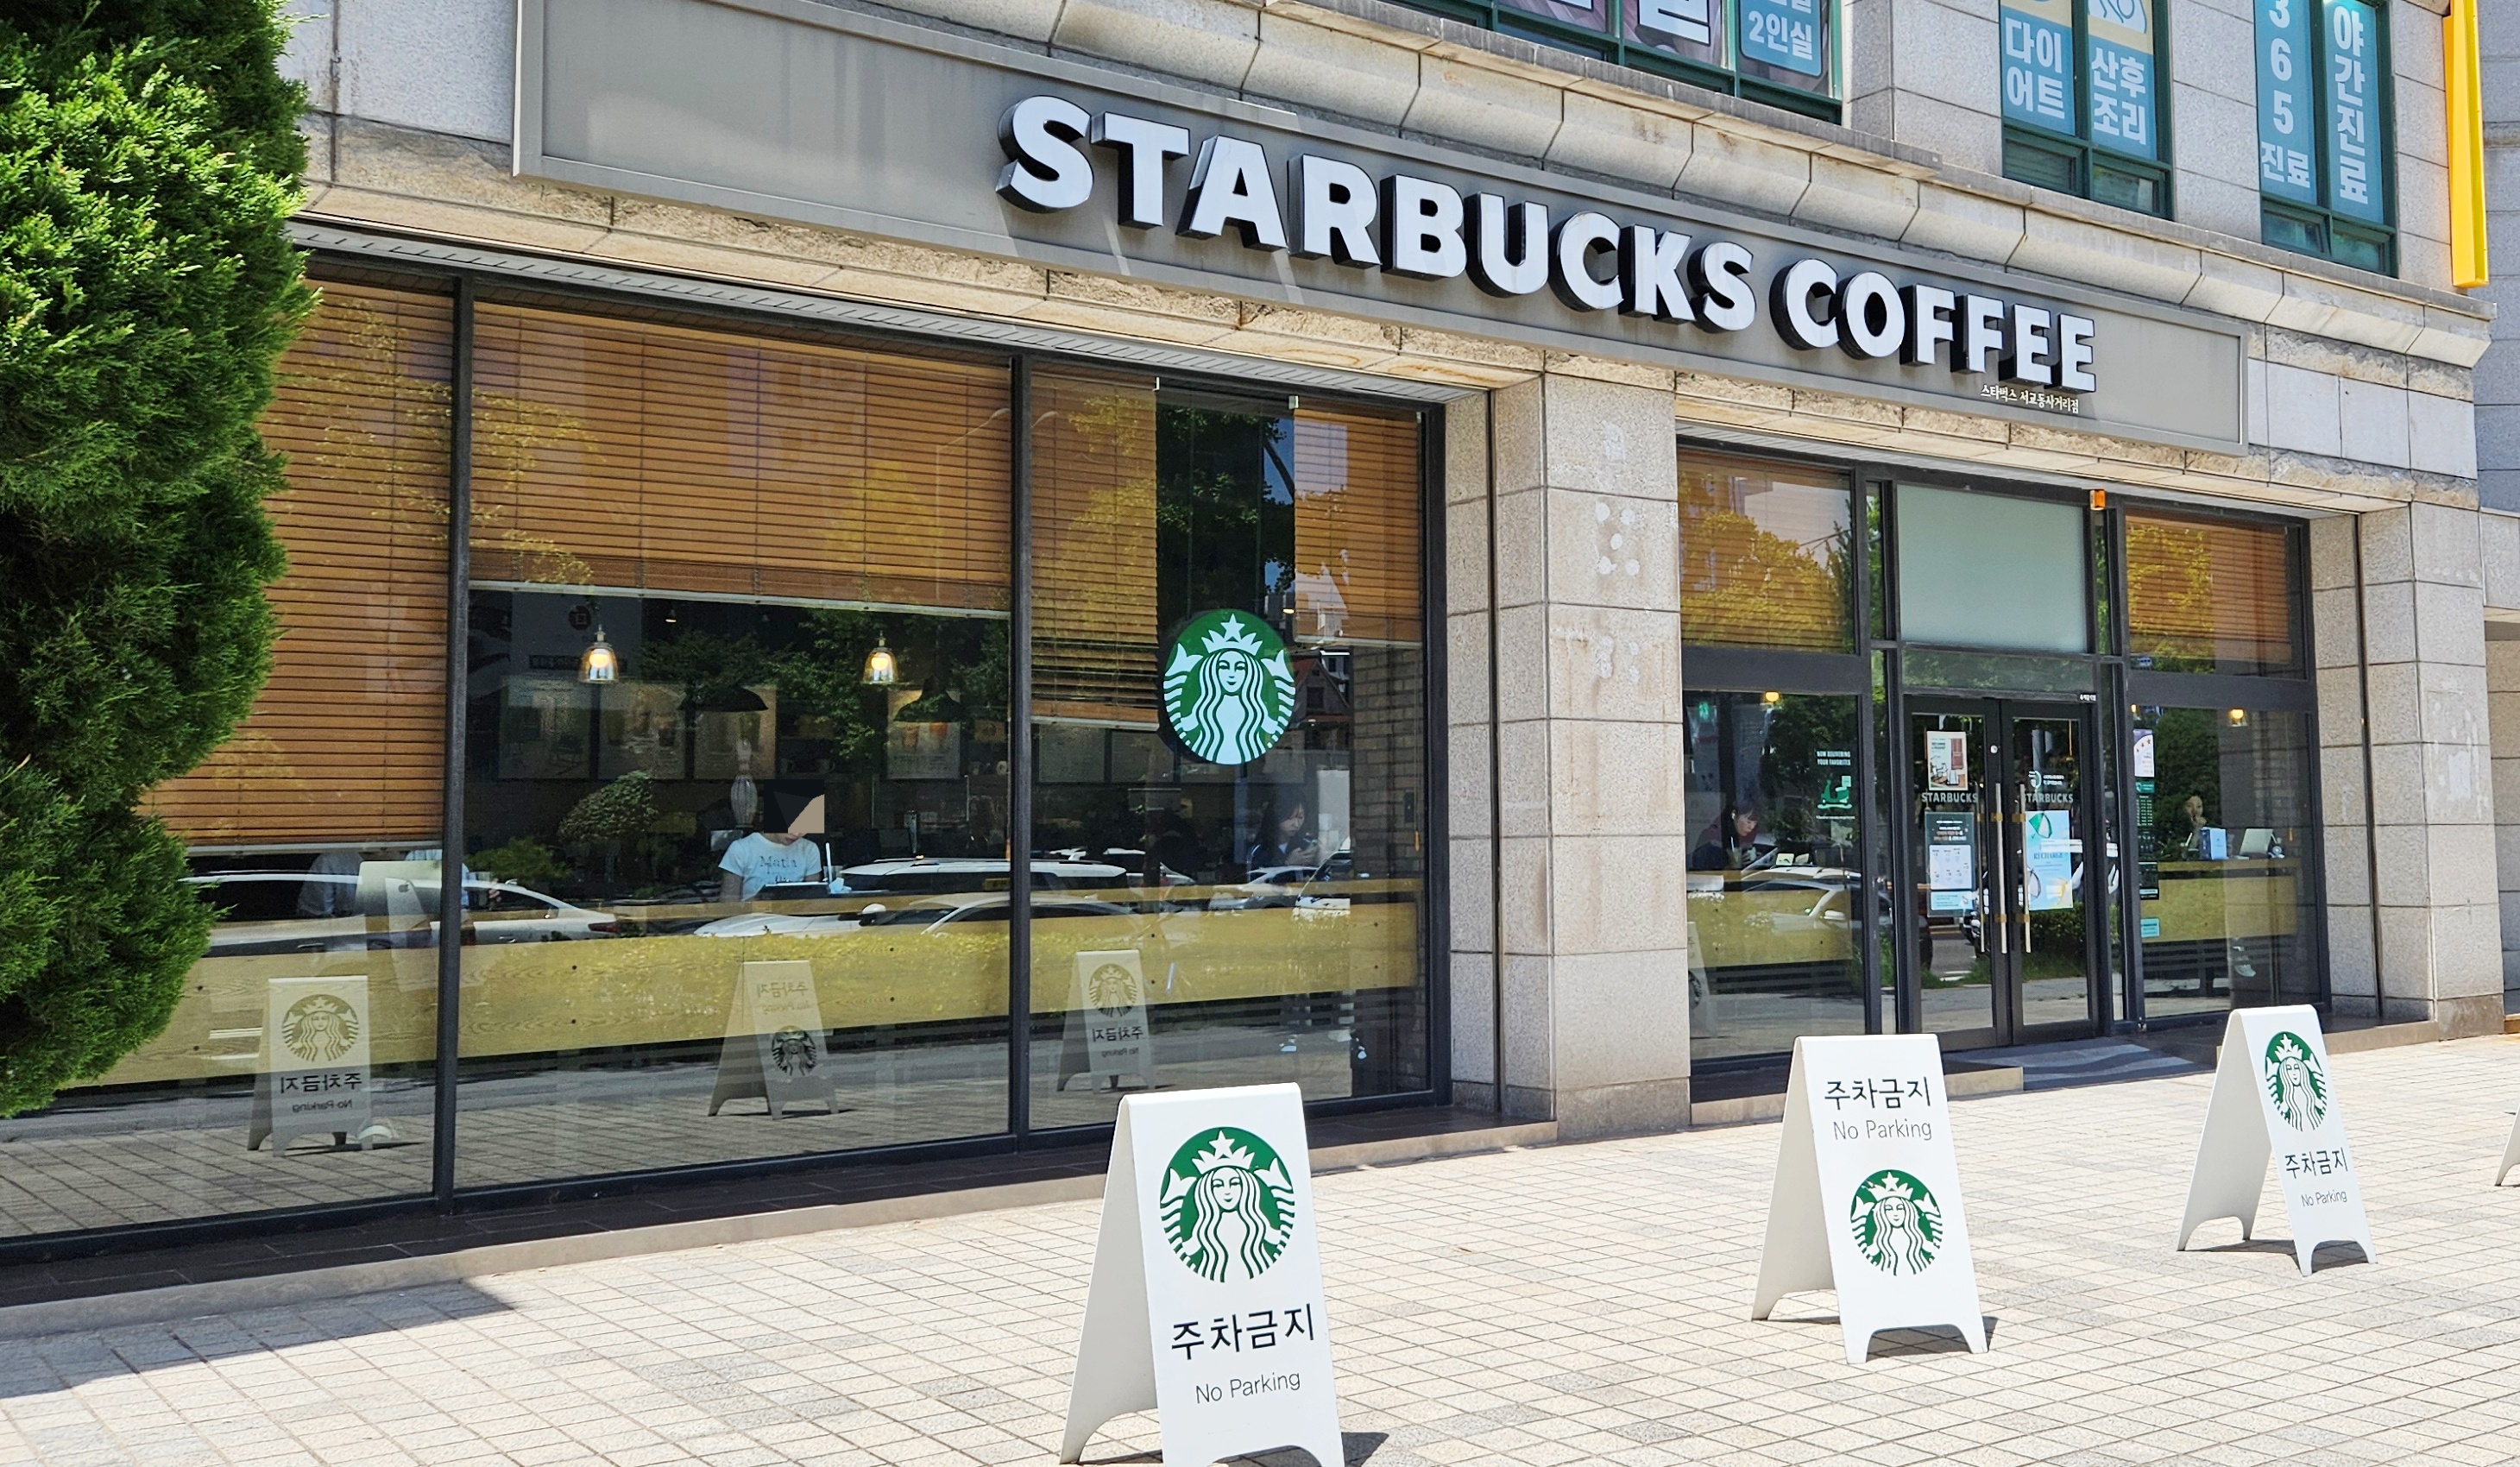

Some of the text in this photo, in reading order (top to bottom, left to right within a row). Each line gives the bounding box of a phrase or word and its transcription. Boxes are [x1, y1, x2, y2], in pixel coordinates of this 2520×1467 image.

[1748, 10, 1812, 60] 2인실
[2091, 47, 2146, 98] 산후
[2091, 92, 2146, 145] 조리
[2334, 5, 2368, 205] 야간진료
[2261, 142, 2310, 188] 진료
[996, 95, 2096, 394] STARBUCKS COFFEE
[1981, 385, 2079, 414] 스타벅스 서교동사거리점
[1921, 792, 1978, 803] STARBUCKS
[2025, 793, 2074, 803] TARBUCKS
[1824, 1076, 1931, 1111] 주차금지
[1833, 1118, 1932, 1141] No Parking
[2285, 1147, 2348, 1179] 주차금지
[2301, 1189, 2347, 1207] No Parking
[1171, 1303, 1314, 1361] 주차금지
[1196, 1371, 1301, 1404] No Parking
